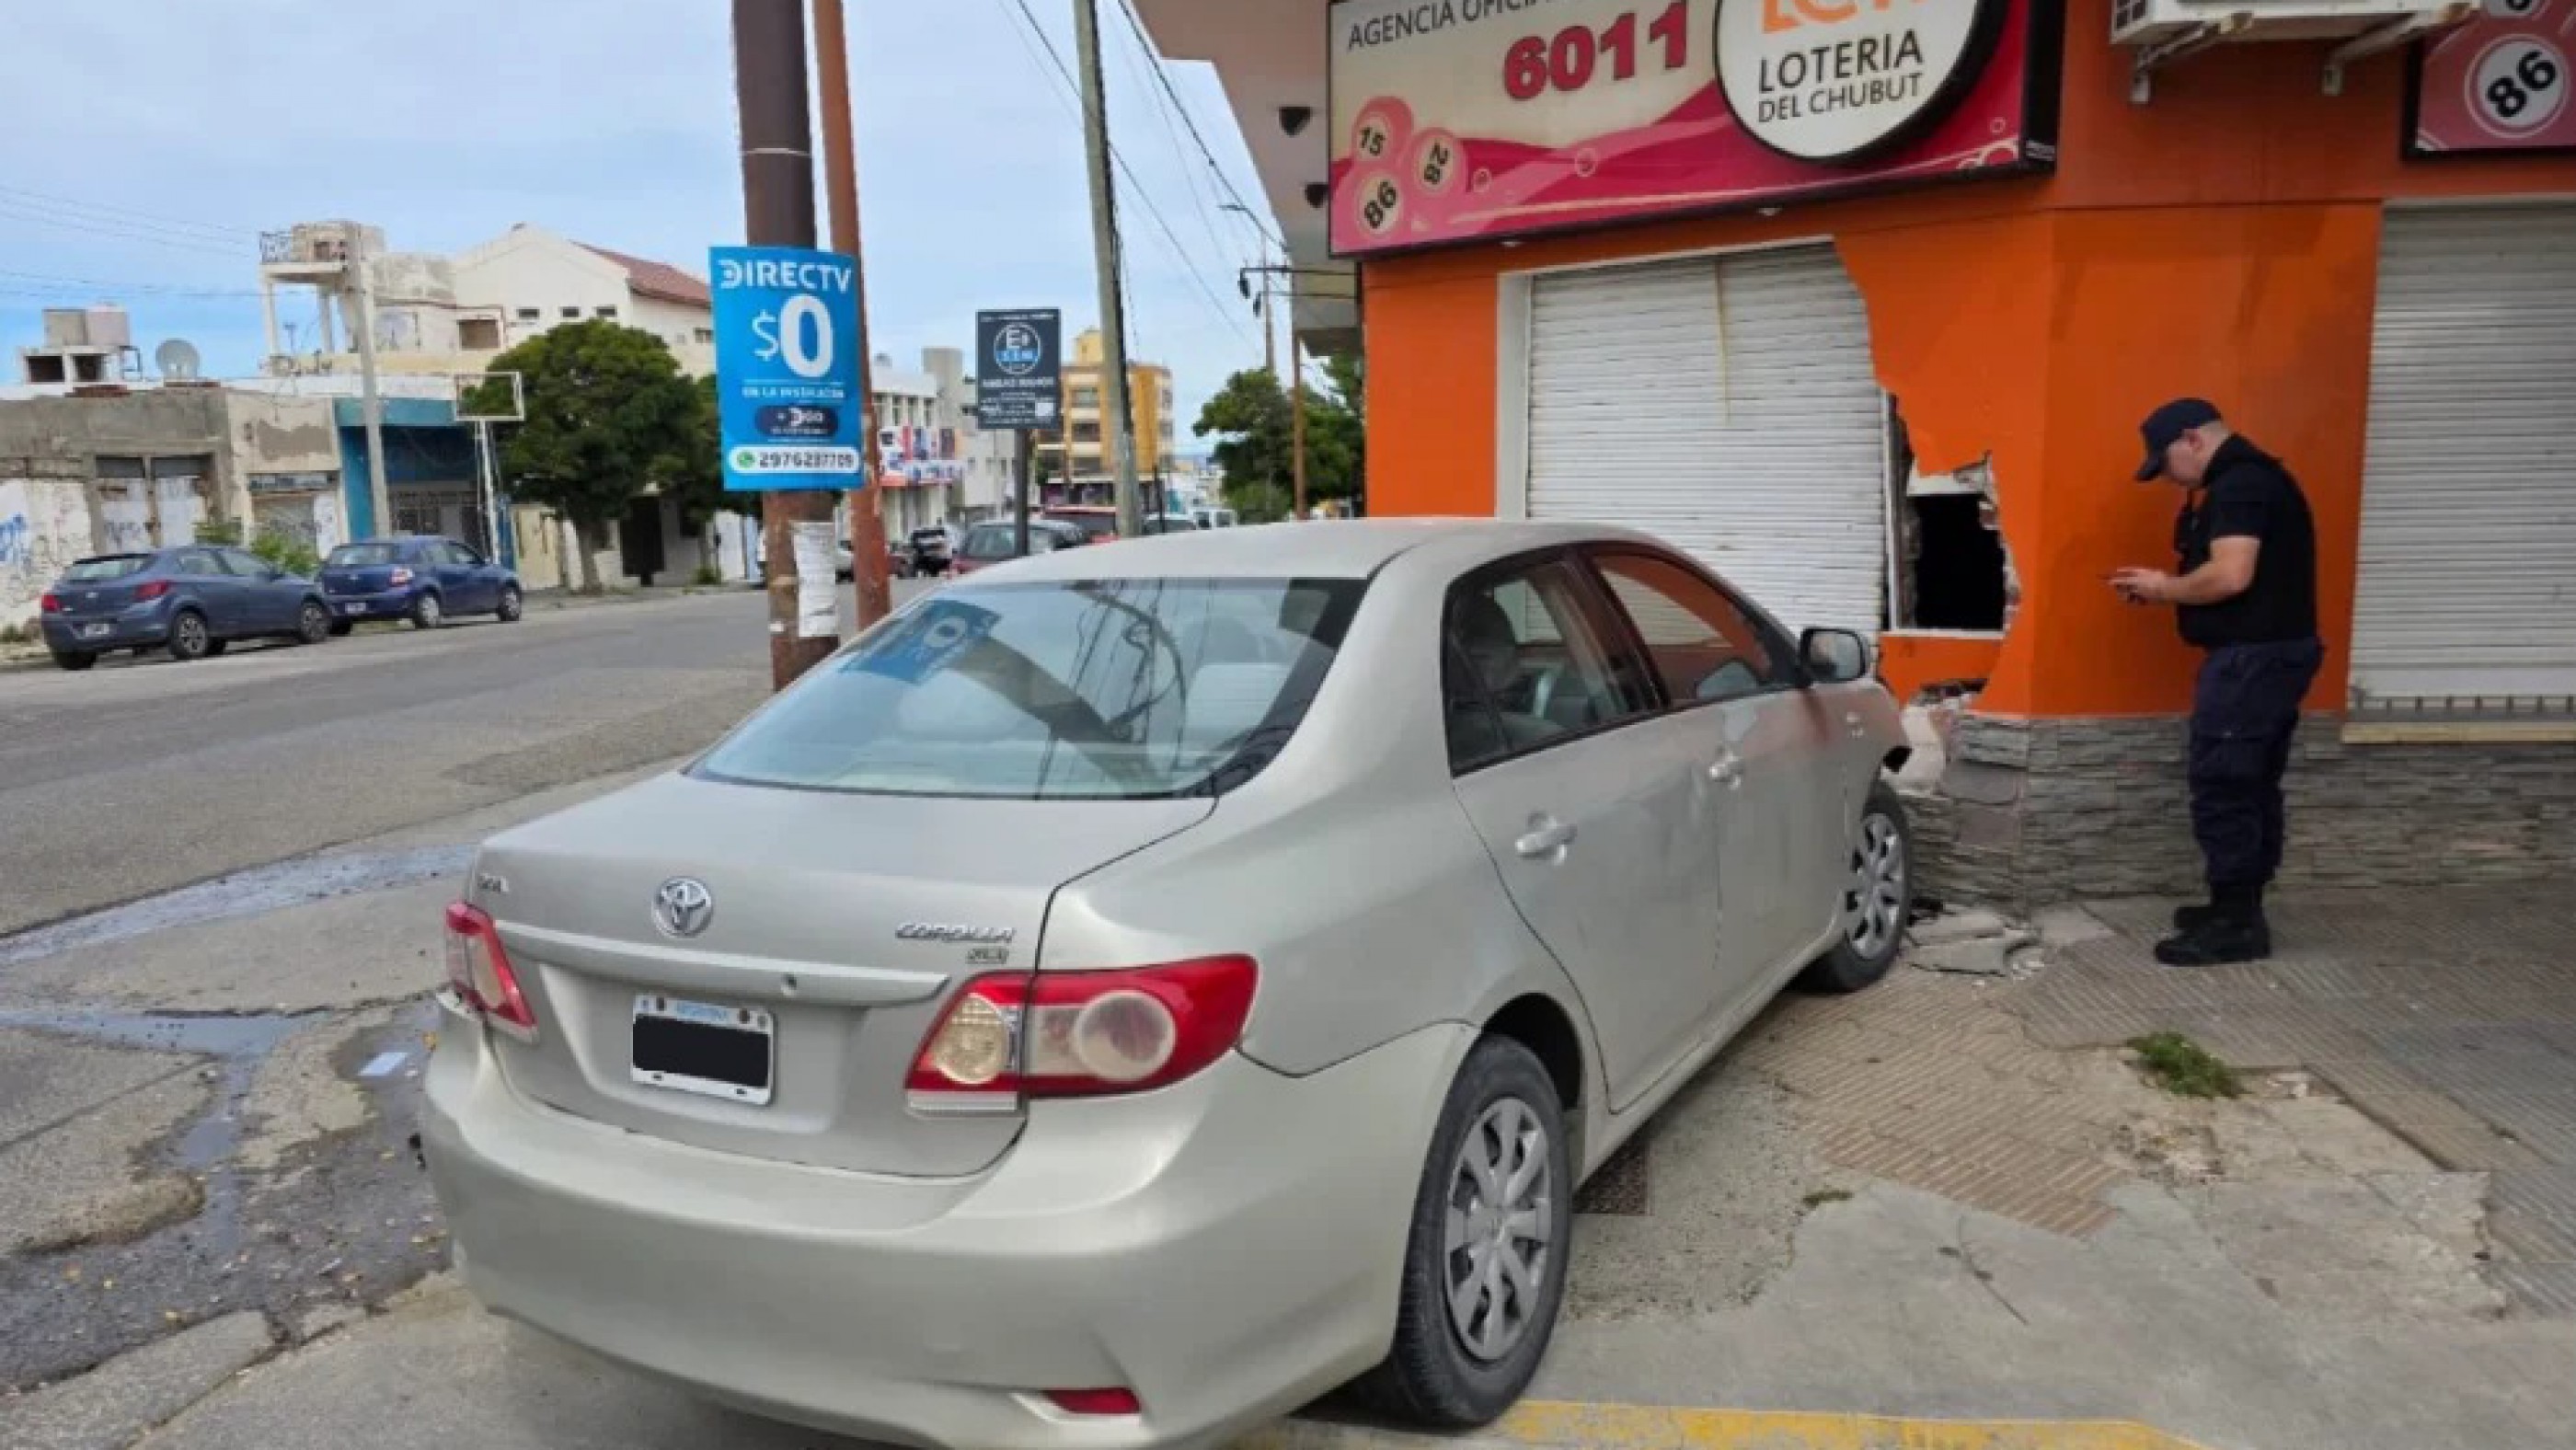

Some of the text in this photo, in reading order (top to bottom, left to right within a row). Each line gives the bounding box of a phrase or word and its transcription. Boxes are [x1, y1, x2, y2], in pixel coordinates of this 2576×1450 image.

[1349, 3, 1455, 52] AGENCIA
[1503, 0, 1689, 100] 6011
[1758, 29, 1924, 93] LOTERIA
[2487, 50, 2557, 118] 86
[1758, 72, 1923, 123] DEL CHUBUT
[1360, 127, 1386, 156] 15
[1364, 180, 1397, 230] 86
[718, 259, 852, 293] DIRECTV
[752, 293, 834, 377] $0
[894, 921, 1017, 944] COROLLA
